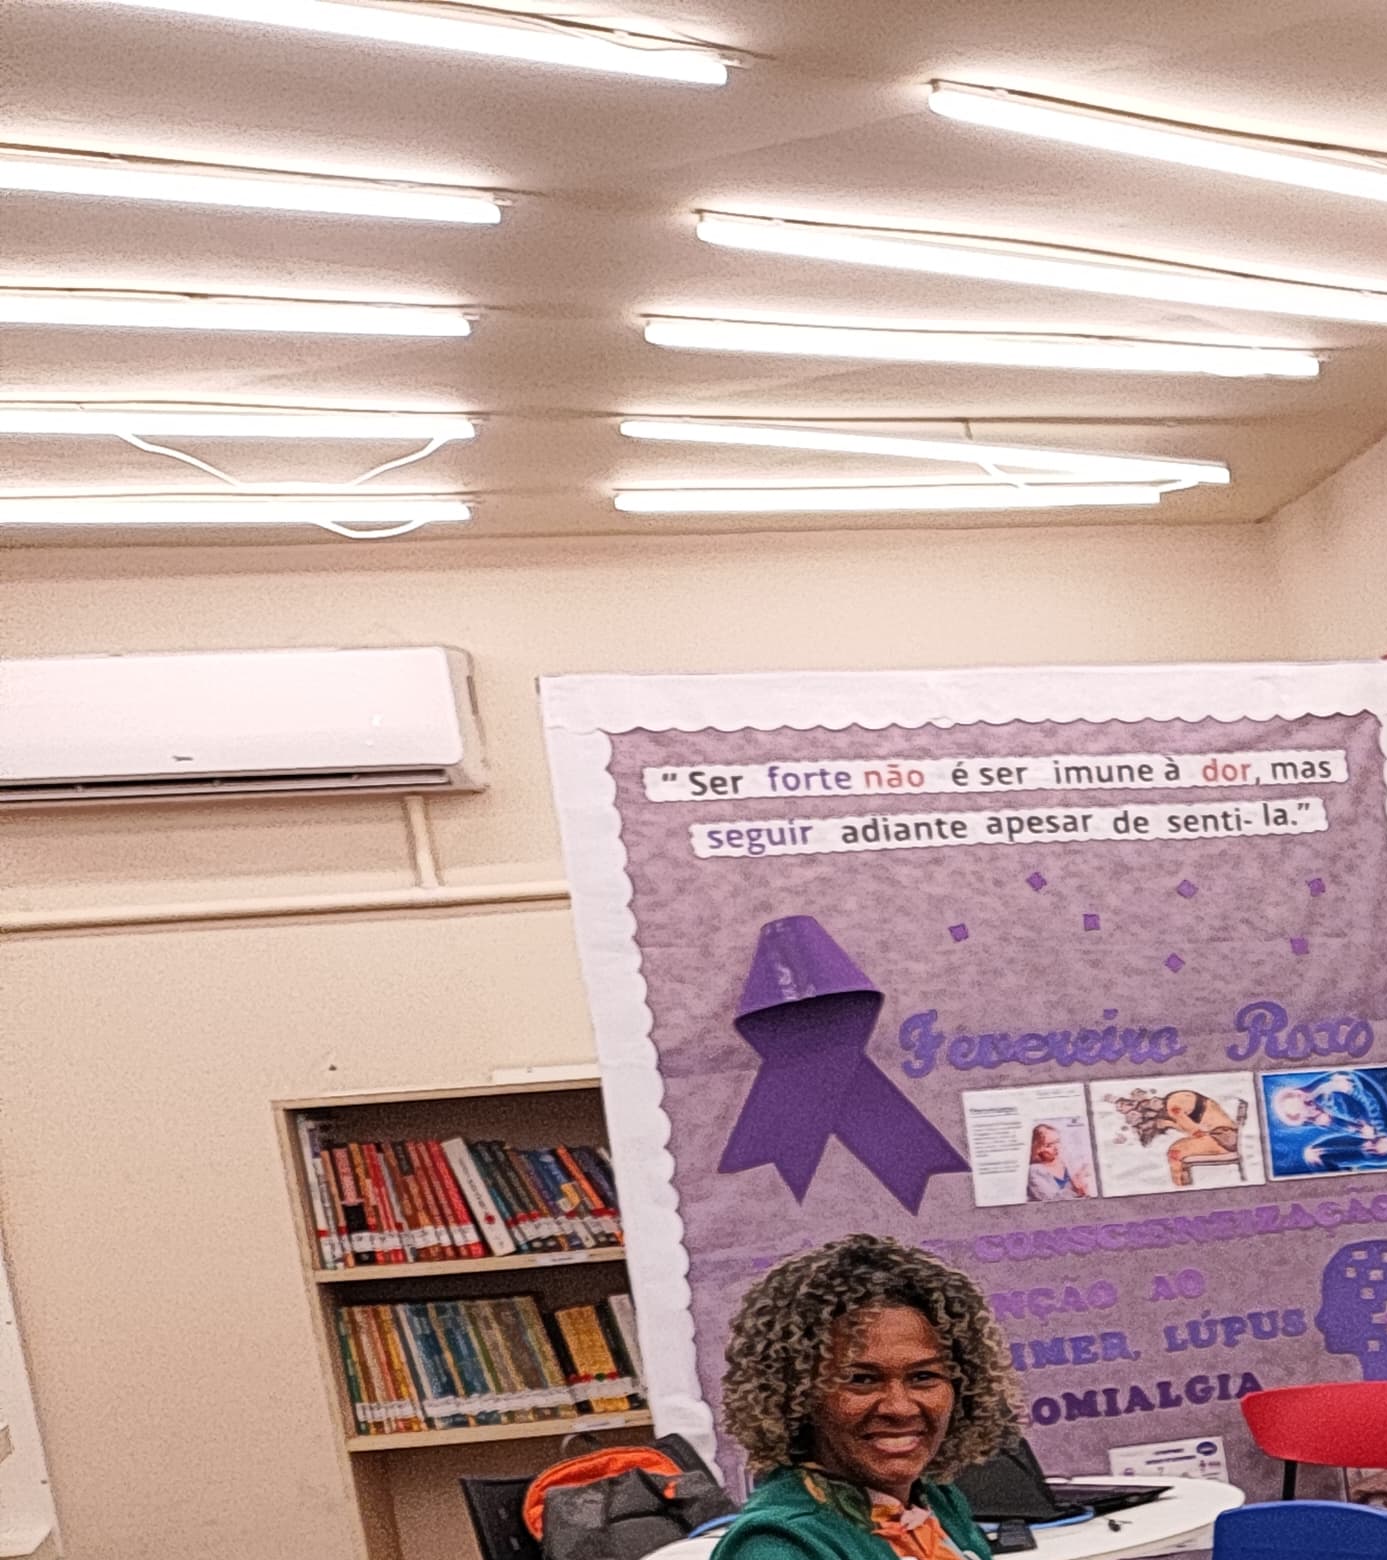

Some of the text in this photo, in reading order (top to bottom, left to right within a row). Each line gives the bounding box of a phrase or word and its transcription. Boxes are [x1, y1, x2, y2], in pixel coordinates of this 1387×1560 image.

[768, 765, 852, 792] forte
[864, 764, 925, 788] não
[951, 761, 968, 786] é
[979, 766, 1028, 787] ser
[1053, 759, 1154, 784] imune
[1164, 756, 1180, 781] à
[1202, 758, 1261, 786] dor,
[1271, 760, 1332, 781] mas
[707, 818, 813, 855] seguir
[842, 818, 968, 845] adiante
[986, 812, 1093, 843] apesar
[1113, 810, 1149, 834] de
[897, 1000, 1375, 1079] Fevereiro Roxo
[989, 1268, 1206, 1326] NÇÃO AO
[1010, 1309, 1308, 1372] IMER, LÚPUS
[1031, 1372, 1263, 1425] OMIALGIA
